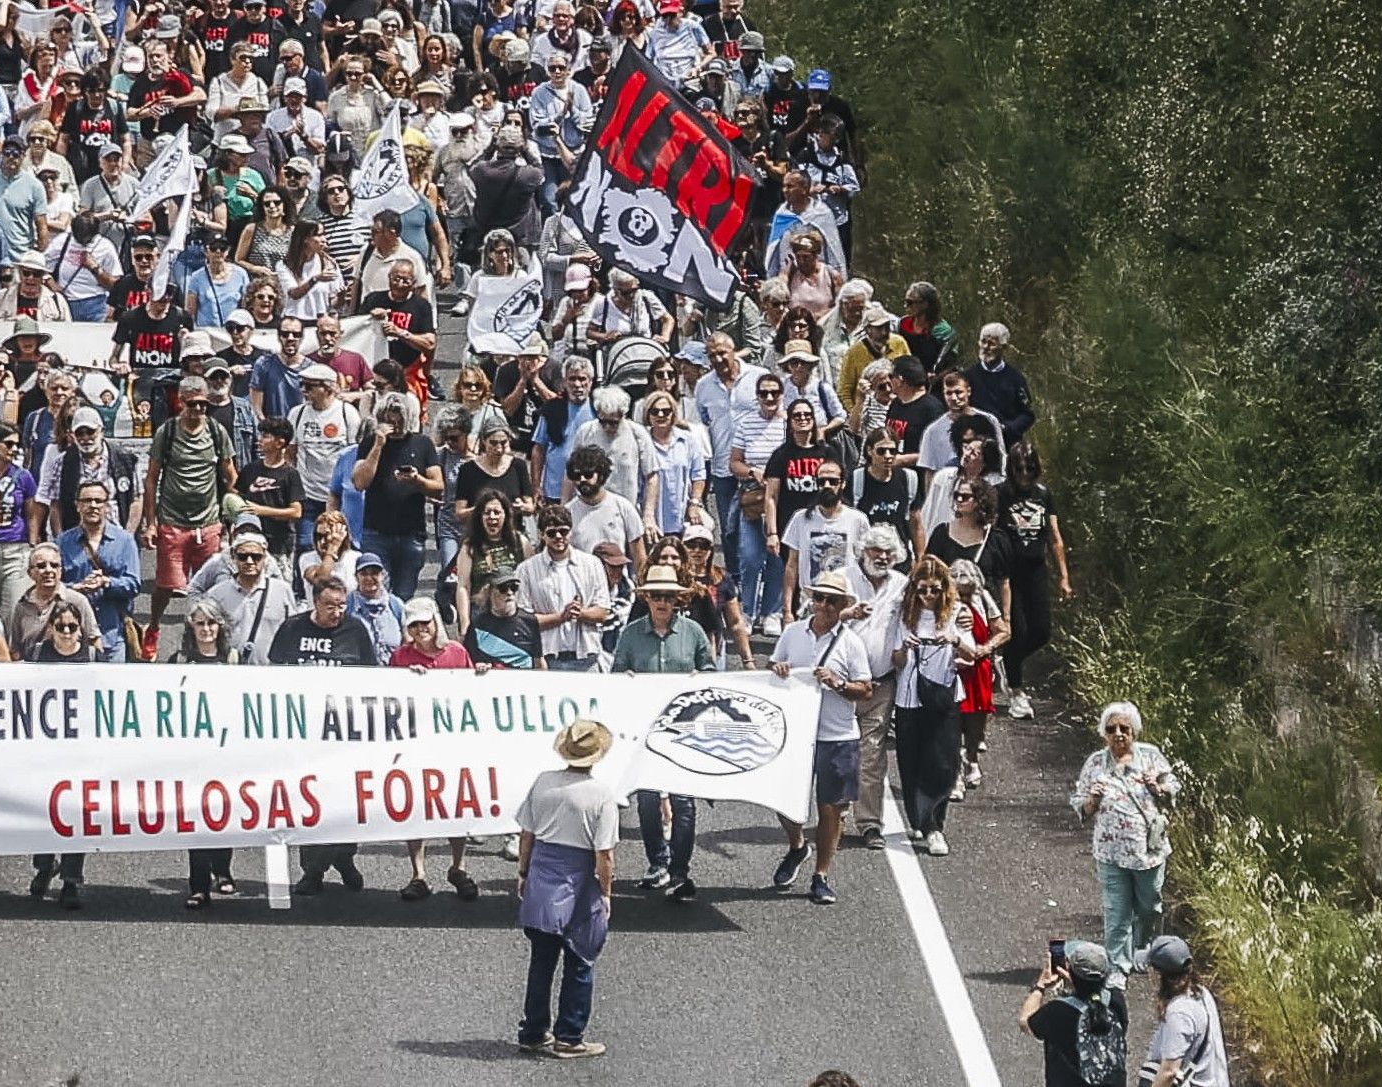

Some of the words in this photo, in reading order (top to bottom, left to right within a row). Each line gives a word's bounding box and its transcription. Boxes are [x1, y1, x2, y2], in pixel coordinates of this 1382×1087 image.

[135, 350, 173, 367] NON
[299, 636, 333, 654] ENCE
[94, 689, 142, 739] NA
[156, 675, 229, 748] RÍA,
[242, 692, 308, 740] NIN
[321, 693, 417, 743] ALTRI
[432, 697, 481, 734] NA
[49, 775, 322, 838] CELULOSAS
[354, 753, 502, 825] FÓRA!
